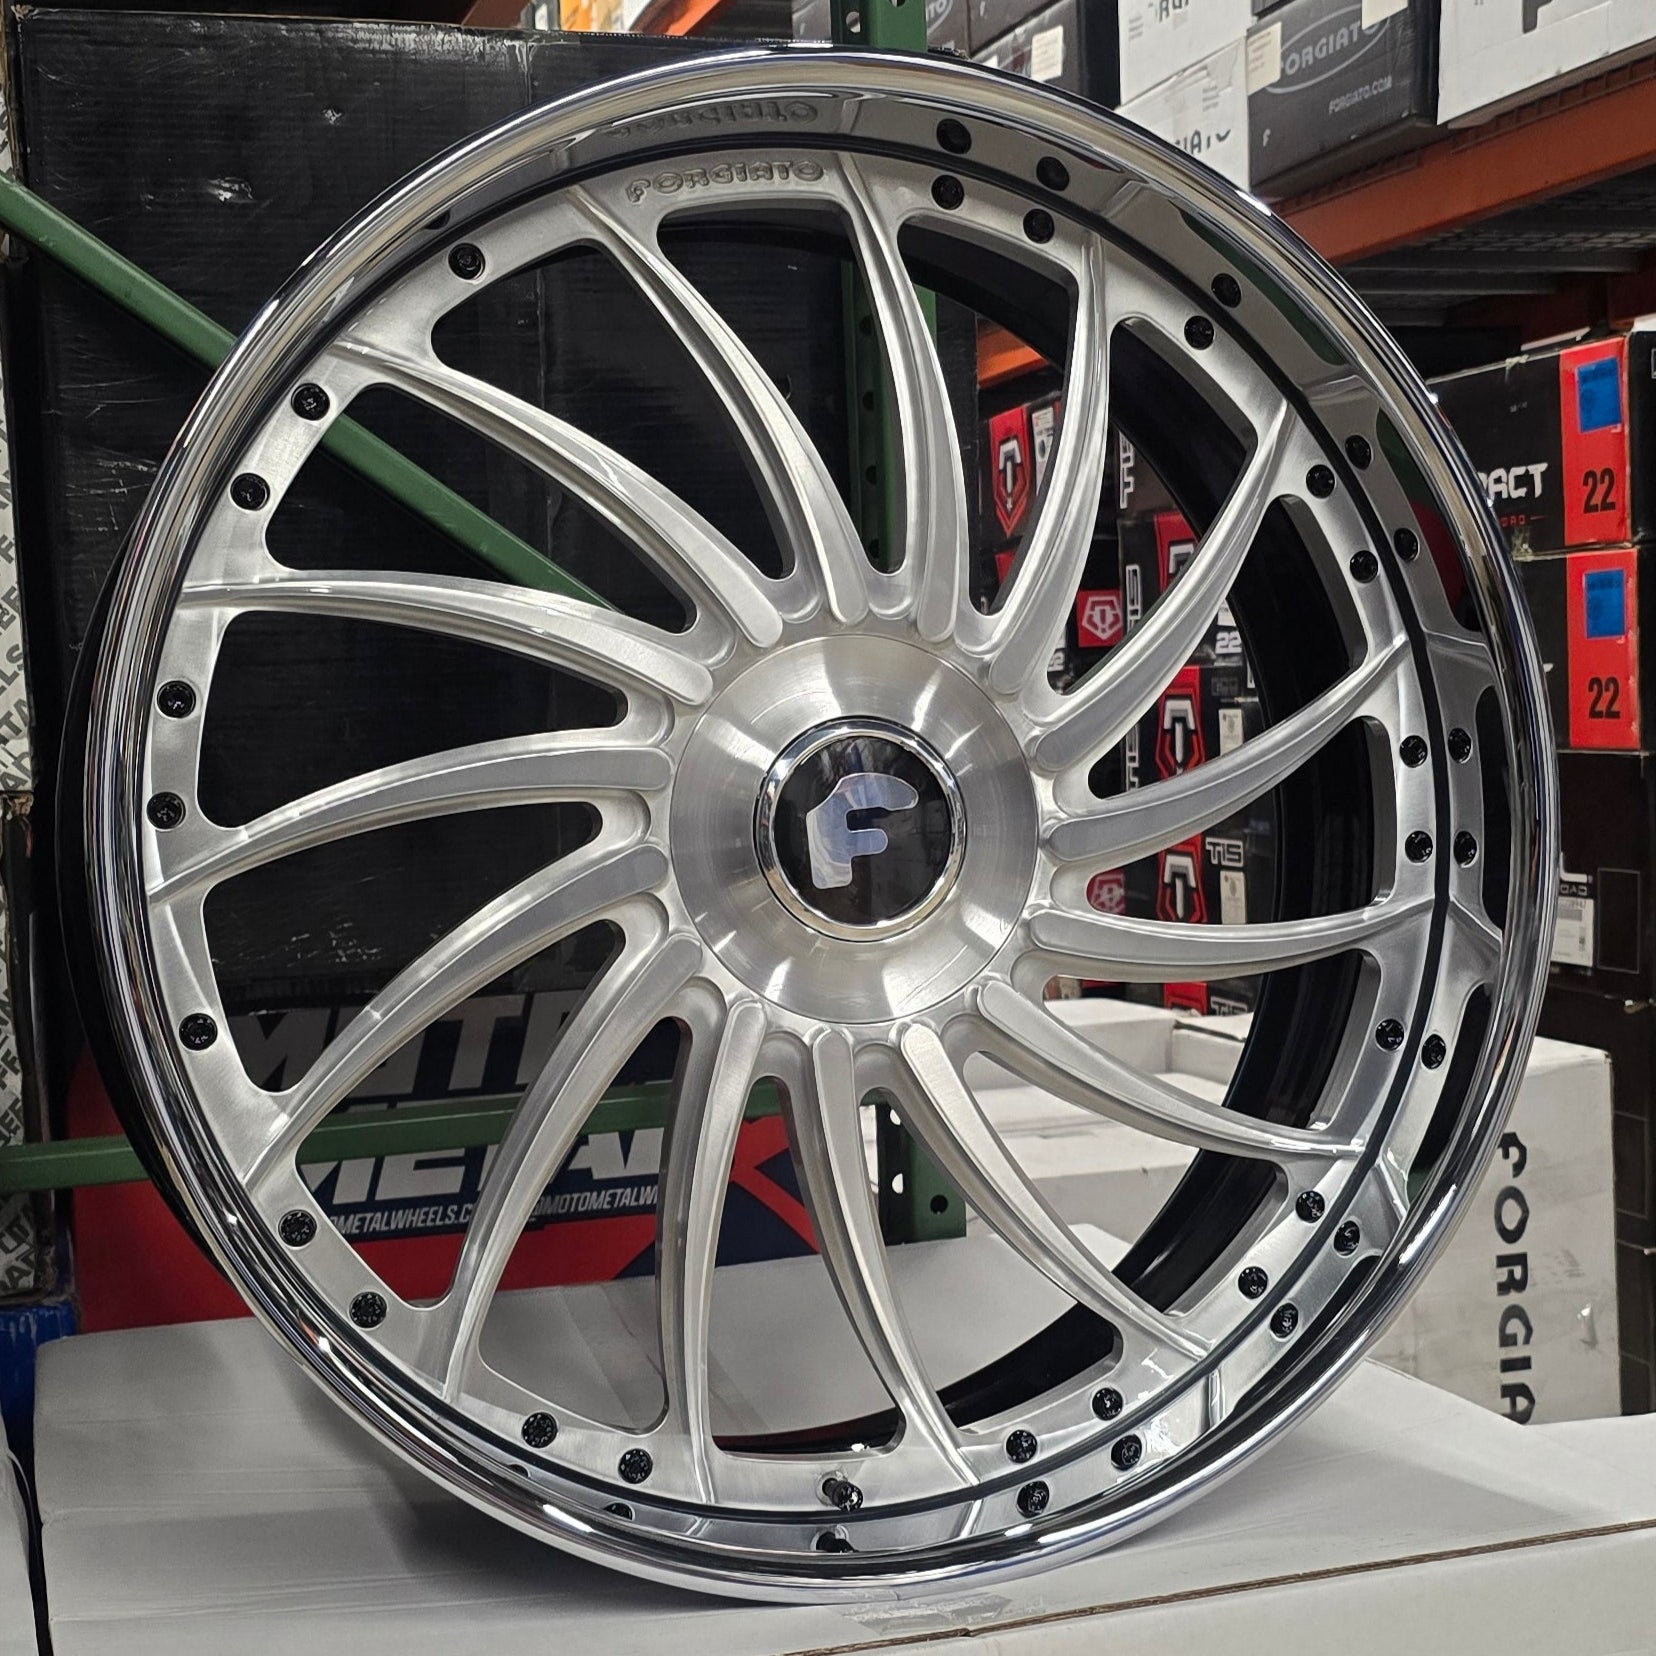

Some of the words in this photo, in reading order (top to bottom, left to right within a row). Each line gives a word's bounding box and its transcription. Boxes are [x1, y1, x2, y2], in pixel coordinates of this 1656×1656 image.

[1280, 21, 1379, 75] ORGIAT
[1328, 75, 1393, 115] FORGIATO.COM
[624, 160, 825, 203] FORGIATO
[1582, 467, 1616, 514] 22
[1215, 631, 1242, 654] 22
[1588, 677, 1621, 719] 22
[1206, 837, 1244, 867] TIS
